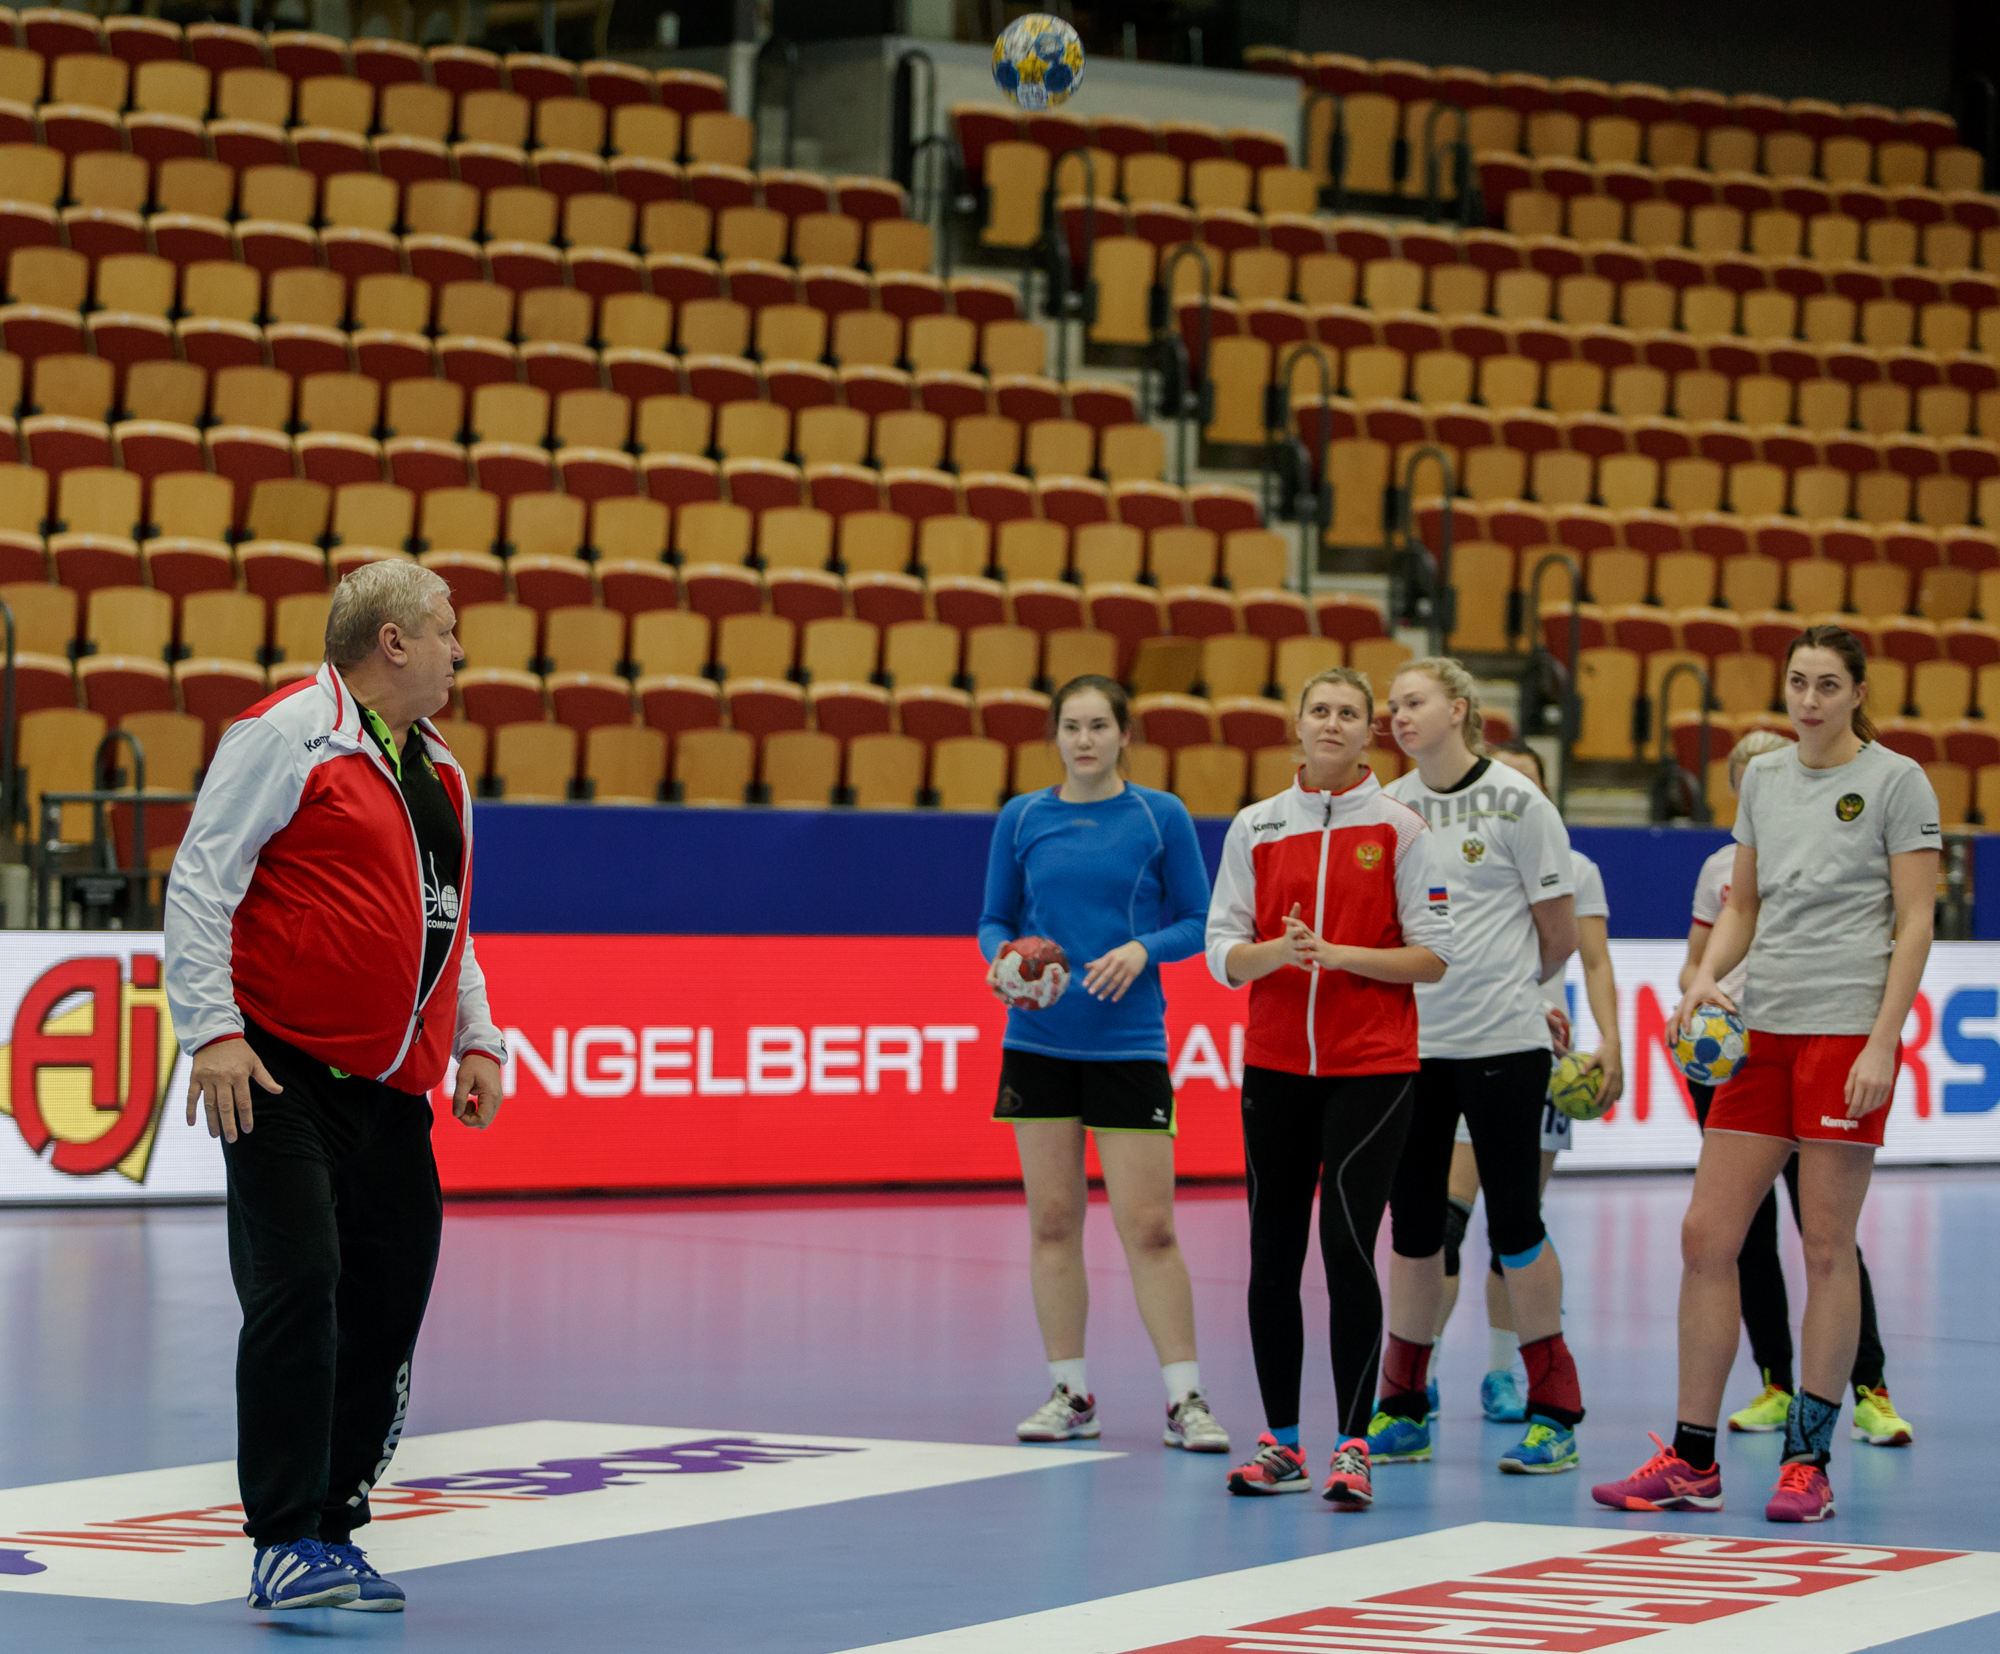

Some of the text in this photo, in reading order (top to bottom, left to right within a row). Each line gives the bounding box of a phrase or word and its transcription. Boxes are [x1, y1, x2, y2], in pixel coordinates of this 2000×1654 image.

[443, 1025, 979, 1098] NGELBERT
[1821, 1115, 1858, 1131] Kempa
[1226, 1539, 1898, 1654] HAUS
